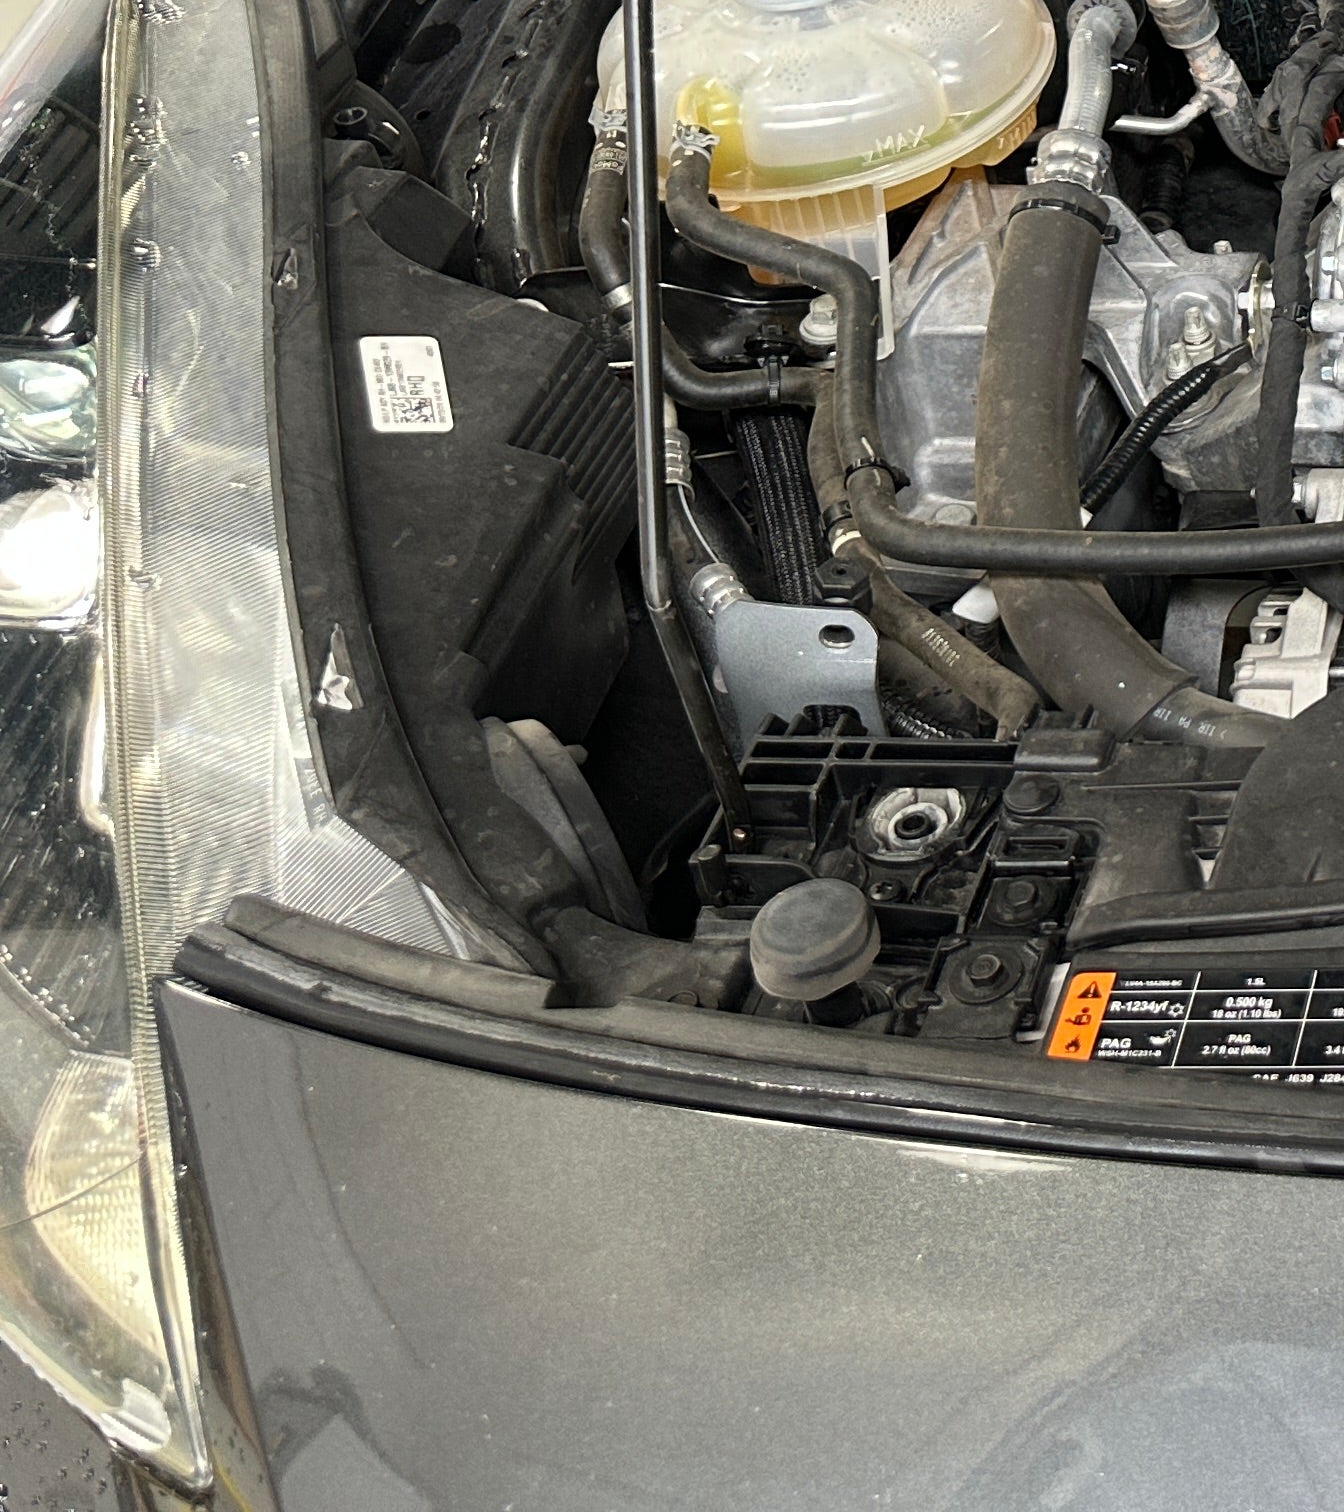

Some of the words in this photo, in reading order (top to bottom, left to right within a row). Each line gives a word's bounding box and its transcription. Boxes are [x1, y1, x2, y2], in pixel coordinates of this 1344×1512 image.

[874, 125, 929, 158] MAX
[1109, 1000, 1170, 1014] R-1234yf
[1225, 996, 1257, 1008] 0.500
[1257, 996, 1274, 1009] kg
[1225, 1010, 1238, 1019] oz
[1263, 1008, 1282, 1019] lbs)
[1100, 1038, 1132, 1049] PAG
[1227, 1034, 1252, 1044] PAG
[1202, 1045, 1218, 1055] 2.7
[1228, 1046, 1240, 1055] oz
[1325, 1045, 1341, 1055] 3.4
